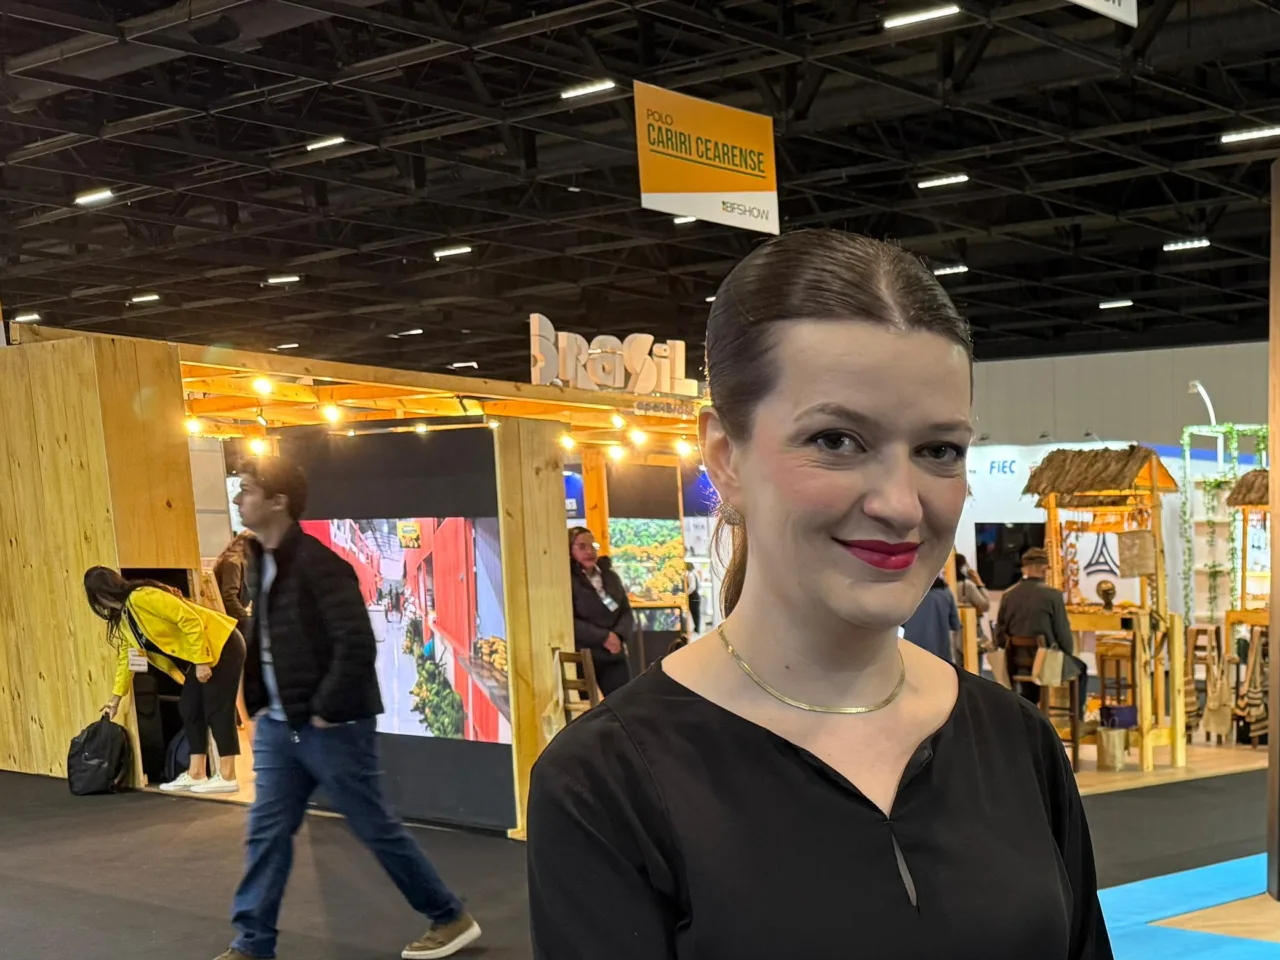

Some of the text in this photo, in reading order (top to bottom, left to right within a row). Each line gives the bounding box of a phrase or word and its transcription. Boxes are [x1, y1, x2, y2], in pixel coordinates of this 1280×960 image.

[646, 108, 674, 126] POLO
[647, 123, 766, 173] CARIRI CEARENSE
